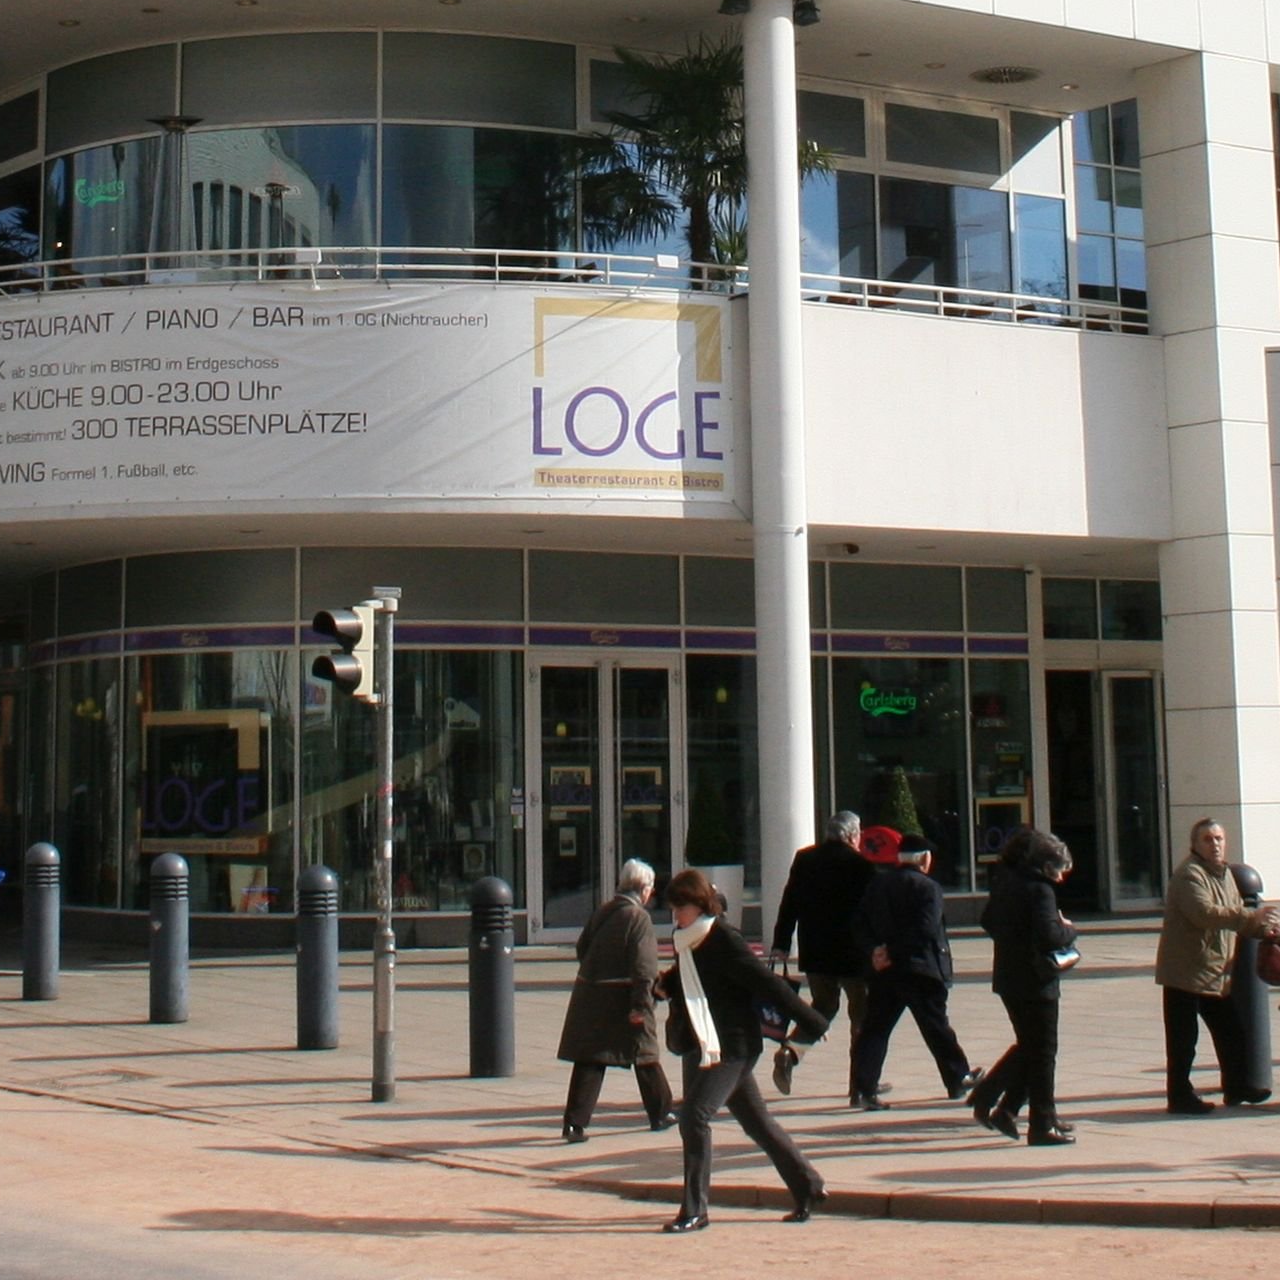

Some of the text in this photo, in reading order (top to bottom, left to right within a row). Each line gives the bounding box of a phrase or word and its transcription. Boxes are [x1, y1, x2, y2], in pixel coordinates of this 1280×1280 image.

[146, 307, 218, 331] PIANO
[252, 307, 304, 327] BAR
[312, 313, 330, 326] im
[354, 312, 376, 326] OG
[381, 312, 488, 328] (Nichtraucher)
[11, 367, 25, 380] ab
[29, 364, 60, 378] 9.00
[63, 362, 86, 376] Uhr
[91, 360, 106, 374] im
[110, 358, 161, 373] BISTRO
[165, 357, 182, 370] im
[187, 357, 279, 372] Erdgeschoss
[12, 386, 83, 411] KÜCHE
[238, 381, 282, 401] Uhr
[6, 429, 67, 445] bestimmt!
[72, 418, 118, 440] 300
[125, 410, 367, 437] TERRASSENPLÄTZE!
[532, 386, 723, 460] LOGE
[51, 467, 96, 482] Formel
[538, 471, 720, 488] Theaterrestaurant & Bistro
[860, 687, 917, 717] Carlsberg
[143, 776, 260, 832] LOGE
